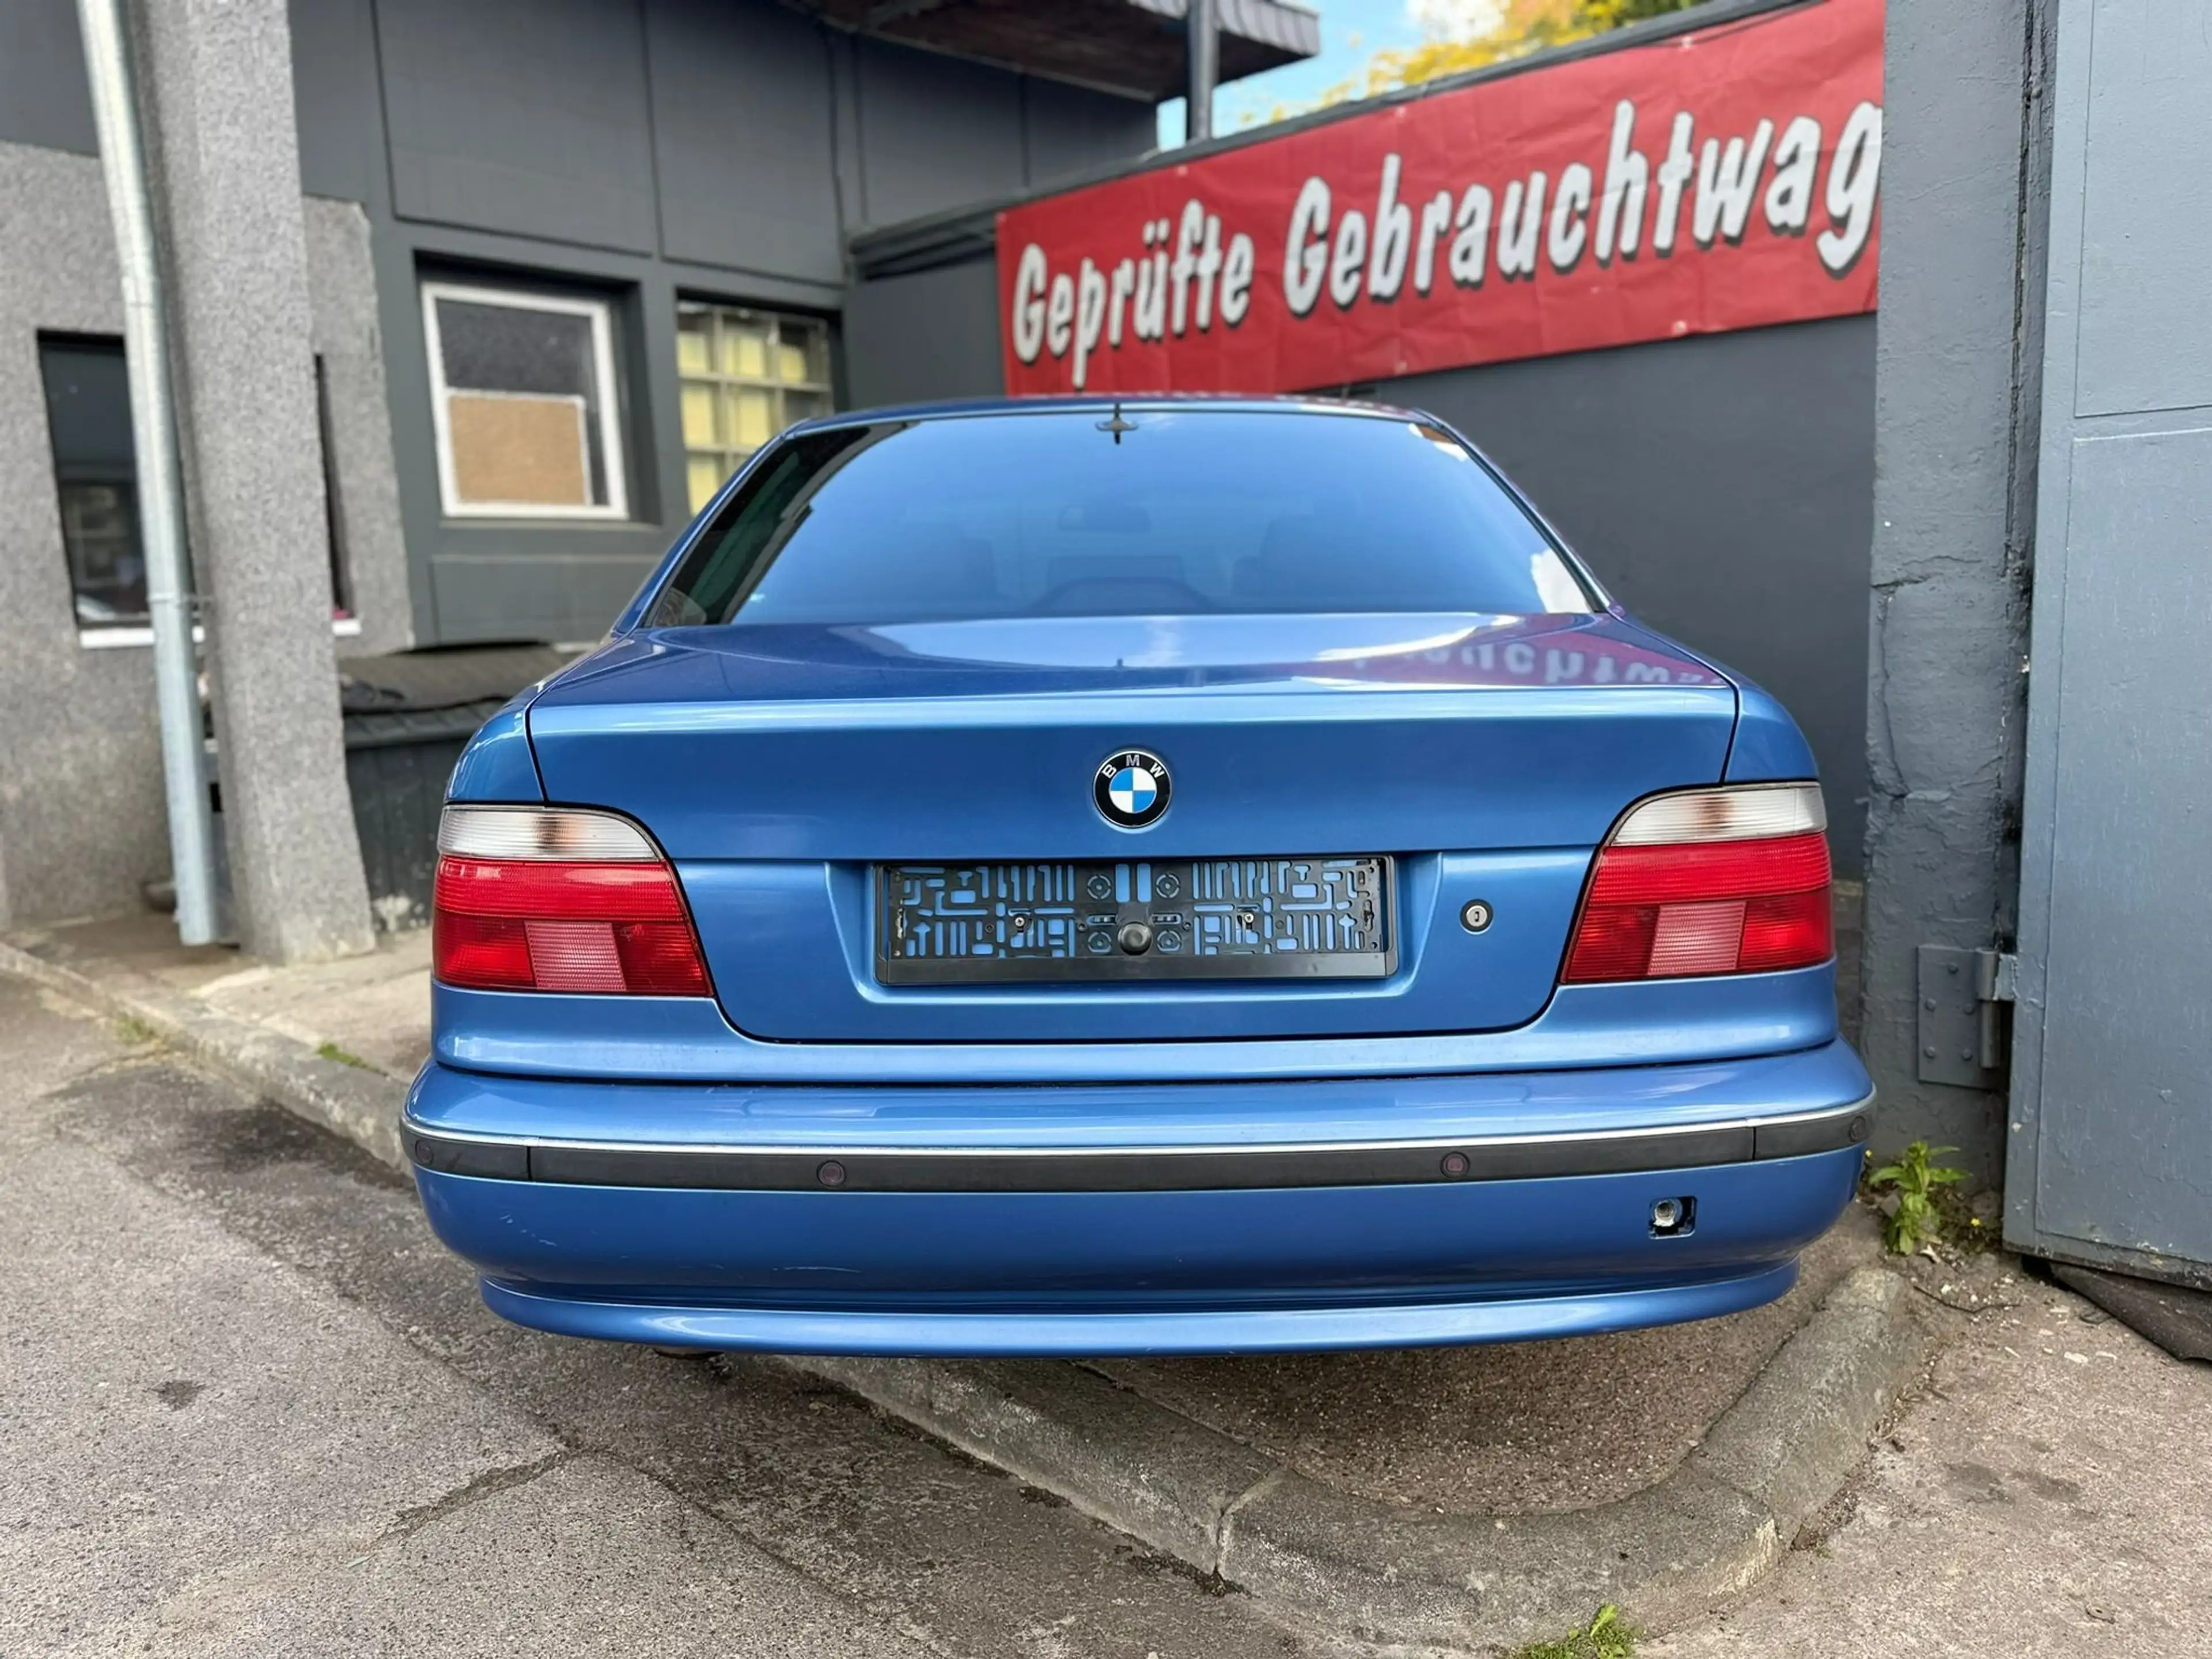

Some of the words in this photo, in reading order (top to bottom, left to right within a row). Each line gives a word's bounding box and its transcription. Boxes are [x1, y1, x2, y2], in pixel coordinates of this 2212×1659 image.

[1012, 199, 1255, 390] Geprüfte
[1282, 98, 1883, 317] Gebrauchtwag
[1101, 754, 1165, 779] BMW
